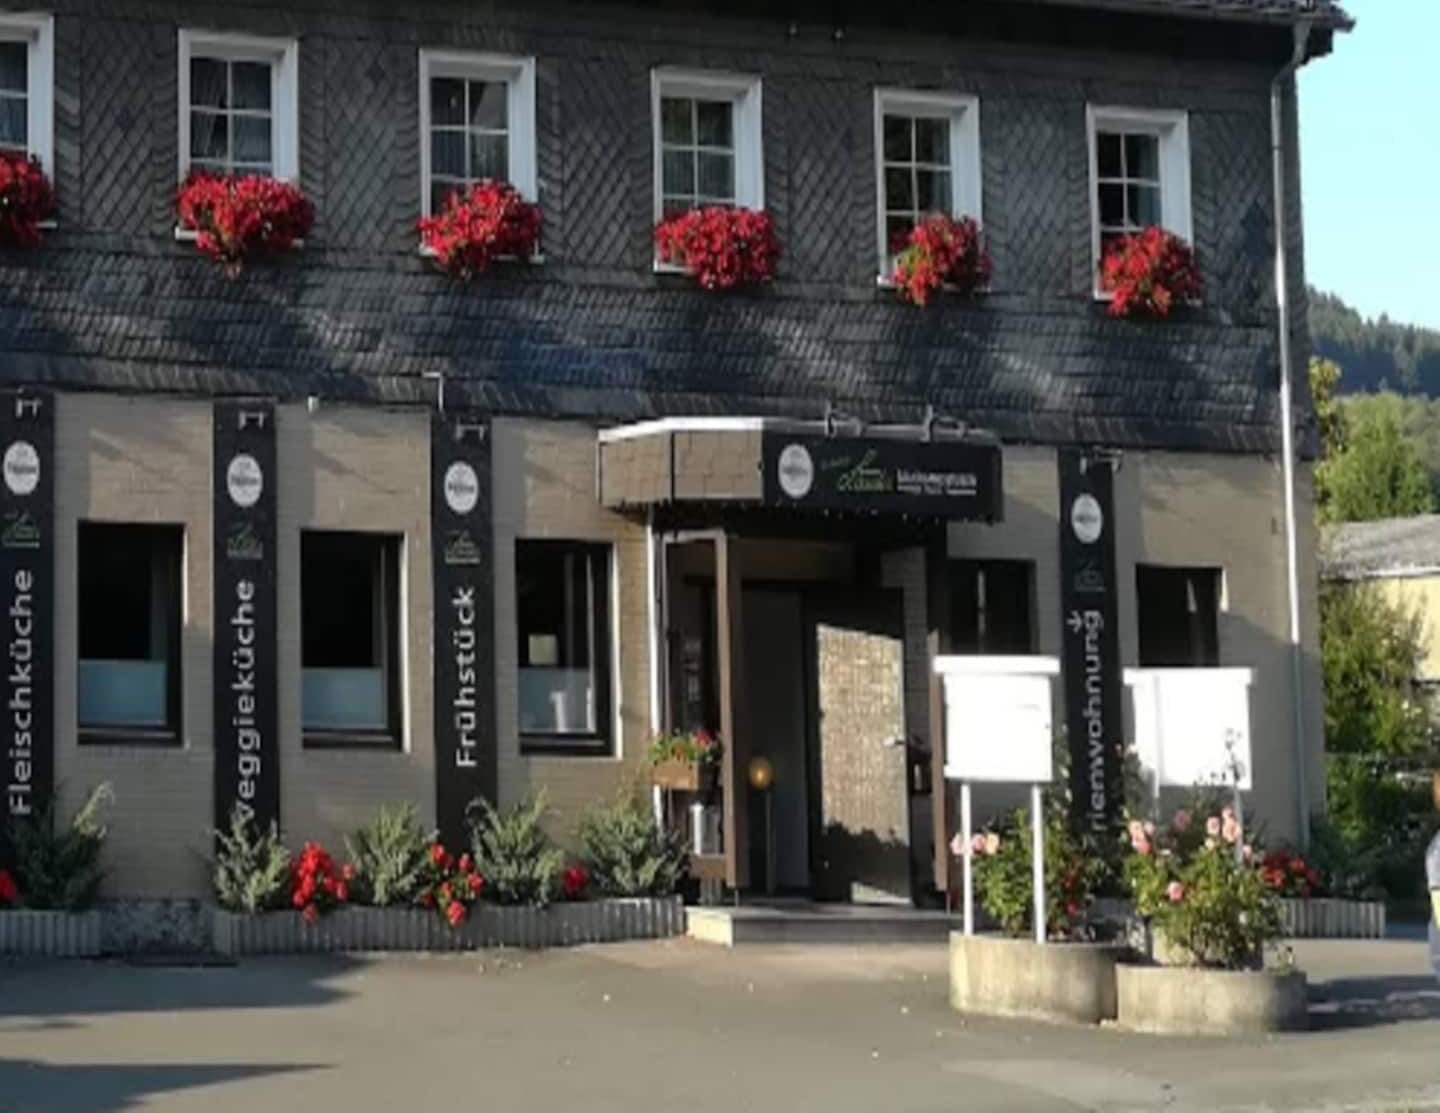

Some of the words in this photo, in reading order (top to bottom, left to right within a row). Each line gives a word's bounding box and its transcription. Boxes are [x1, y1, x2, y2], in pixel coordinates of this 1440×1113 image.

[9, 569, 33, 815] Fleischküche
[452, 585, 477, 768] Frühstück
[1082, 610, 1108, 832] rienwohnung
